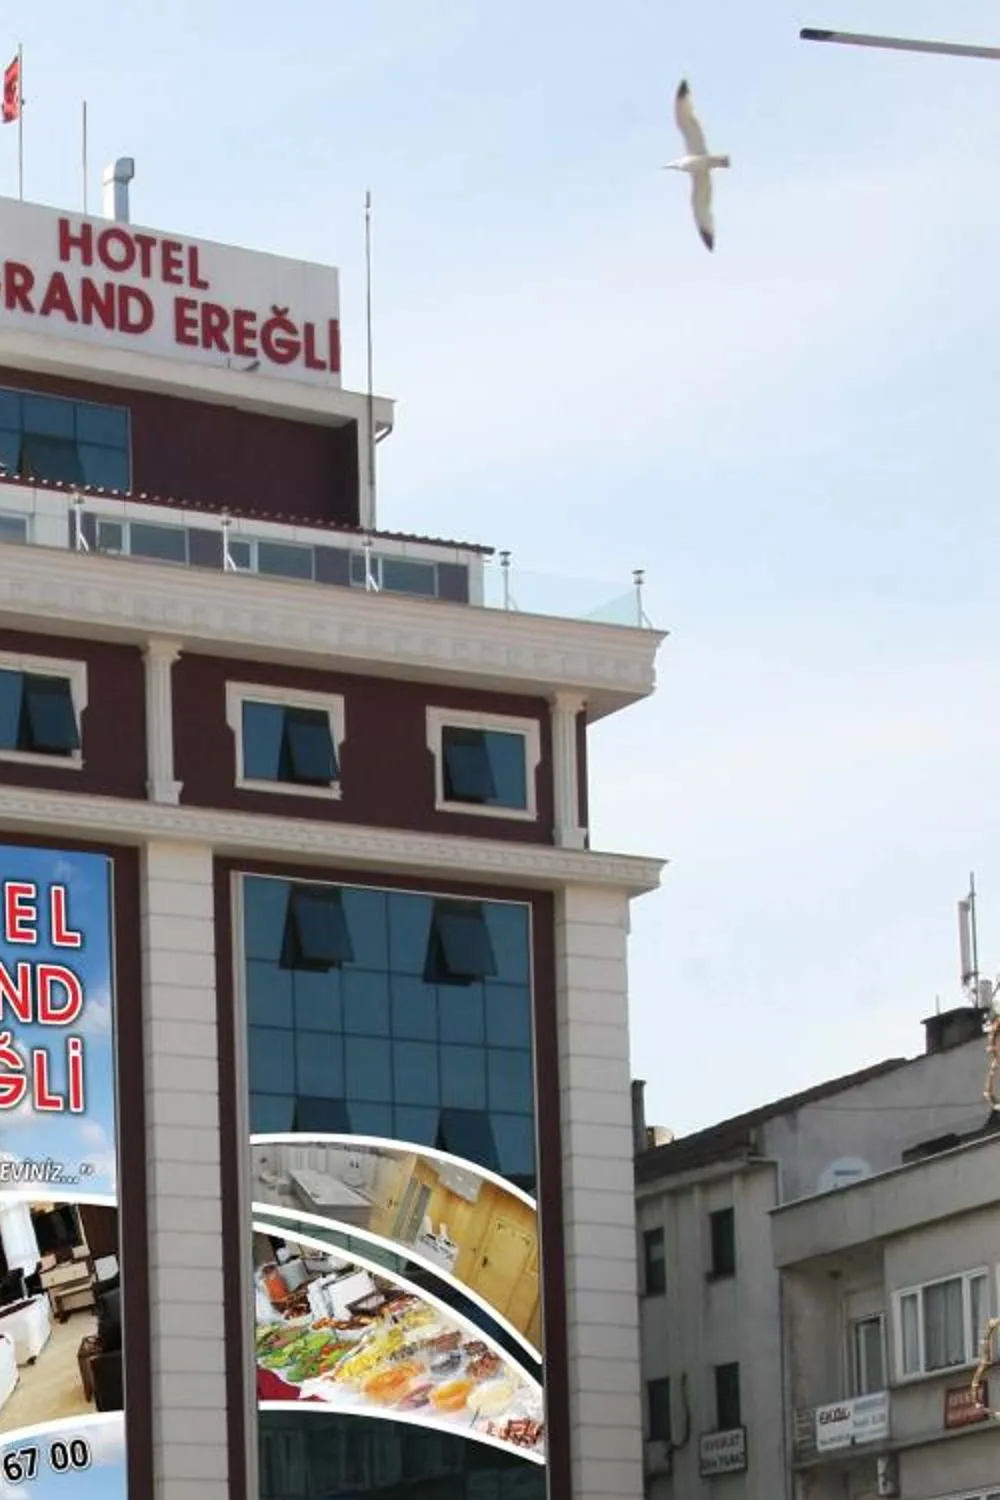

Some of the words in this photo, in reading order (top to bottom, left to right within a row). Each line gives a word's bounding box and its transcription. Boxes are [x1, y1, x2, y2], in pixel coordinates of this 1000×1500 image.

[58, 217, 210, 290] HOTEL
[174, 297, 341, 374] EREĞLİ
[3, 1447, 38, 1482] 67
[50, 1438, 90, 1471] 00
